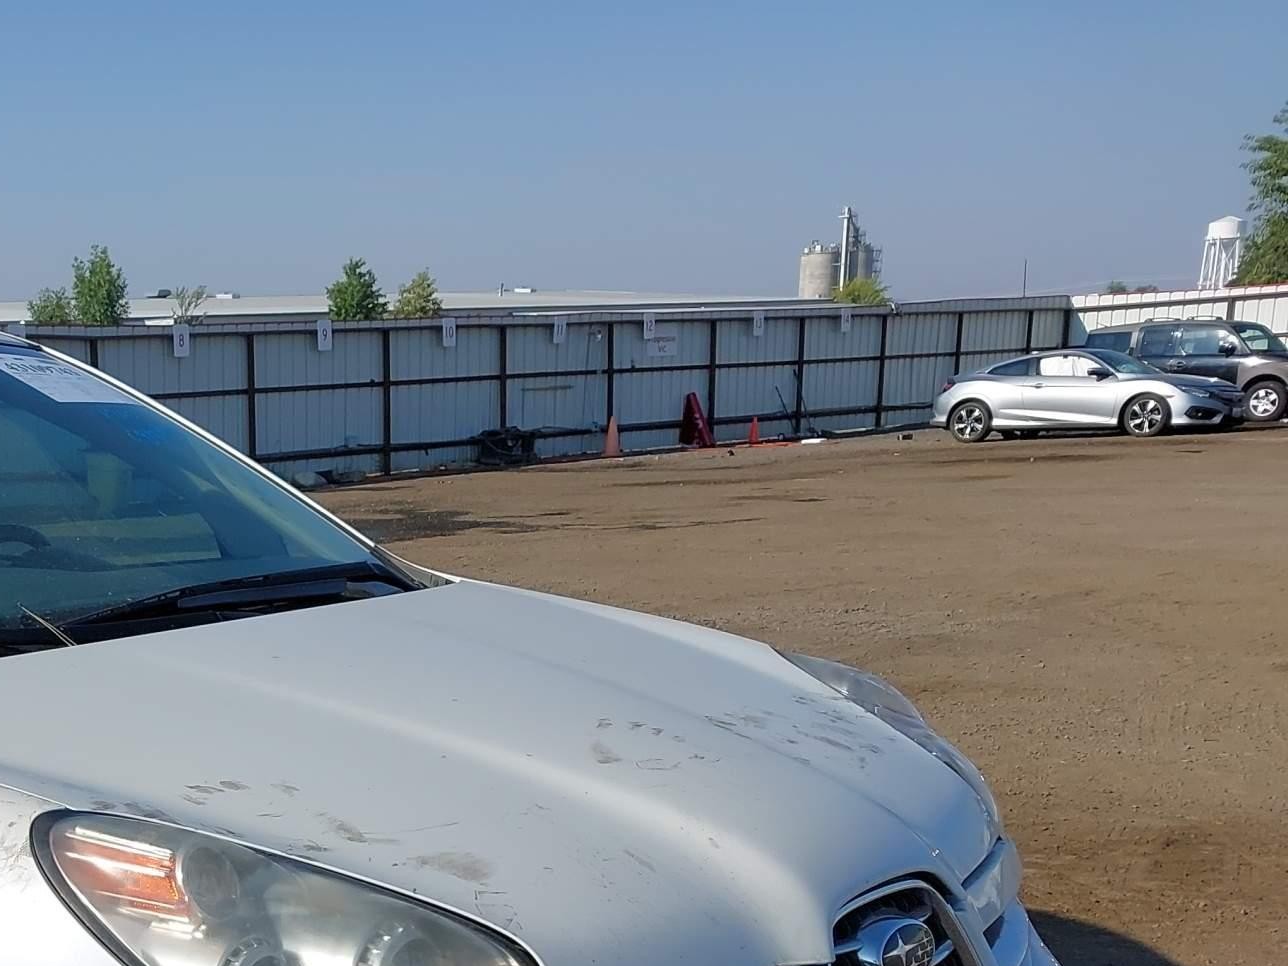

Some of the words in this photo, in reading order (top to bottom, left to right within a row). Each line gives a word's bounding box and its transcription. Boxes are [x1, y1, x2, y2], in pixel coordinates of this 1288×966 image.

[444, 326, 454, 338] 10
[646, 319, 655, 332] 12
[178, 334, 185, 348] 8
[322, 328, 328, 341] 9
